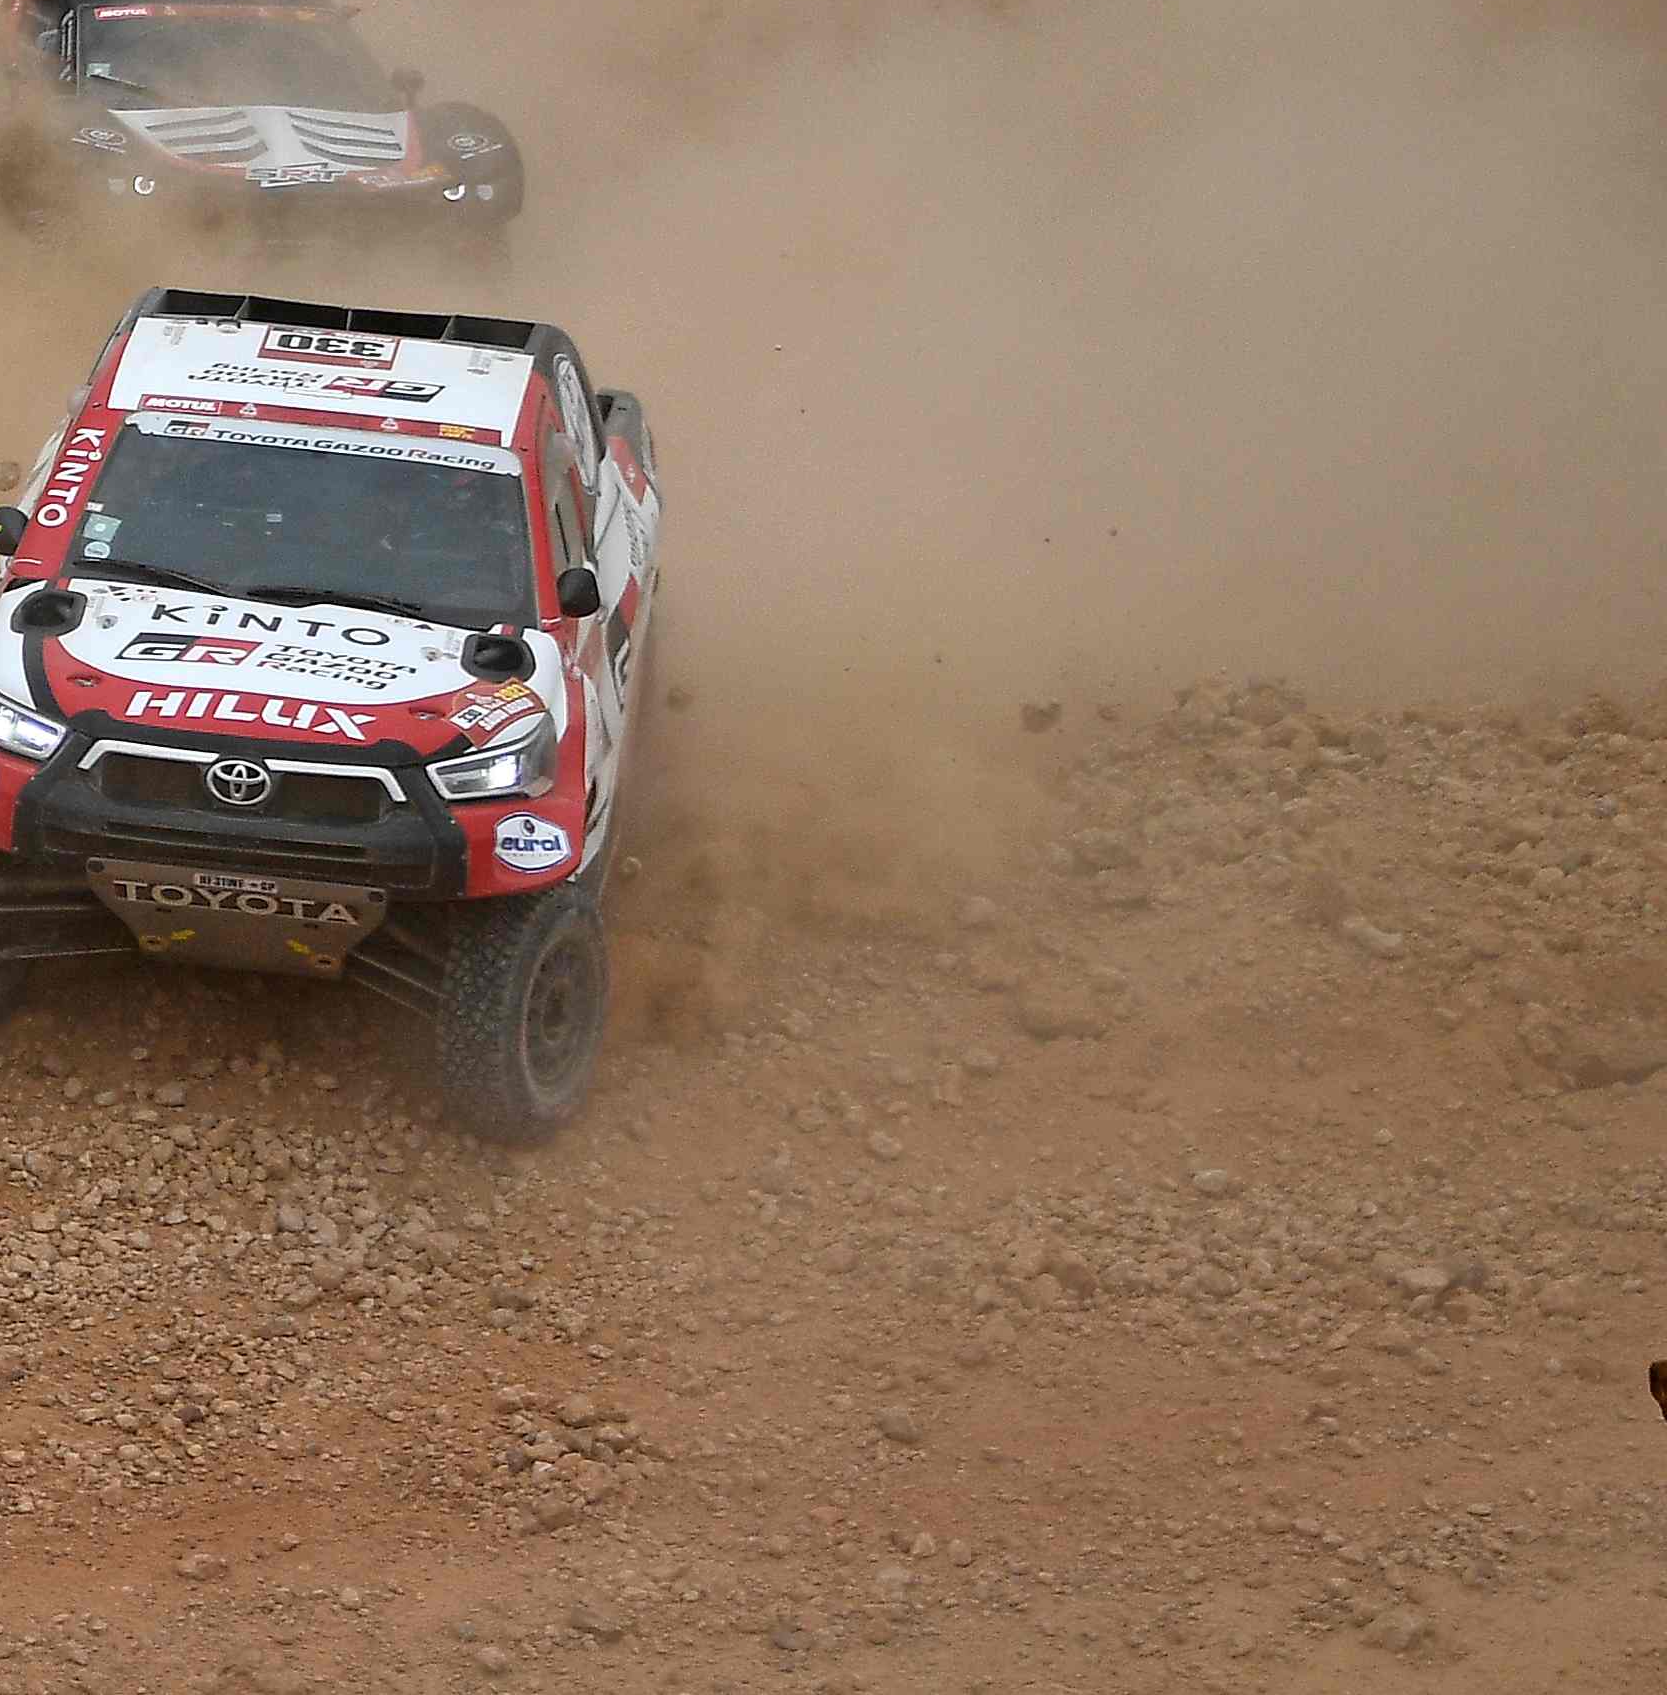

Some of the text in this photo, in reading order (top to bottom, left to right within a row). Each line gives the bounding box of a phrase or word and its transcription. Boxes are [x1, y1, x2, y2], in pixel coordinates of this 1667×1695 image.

[98, 7, 149, 18] MOTUL
[276, 333, 385, 359] 330
[146, 396, 218, 412] MOTUL
[165, 420, 497, 472] GR TOYOTA GAZOO Racing
[116, 632, 264, 666] GR
[275, 643, 418, 675] TOYOTA
[257, 660, 388, 691] Racing
[265, 652, 399, 680] GAZOO
[124, 690, 377, 741] HILUX
[500, 835, 562, 852] eurol
[113, 879, 361, 927] TOYOTA
